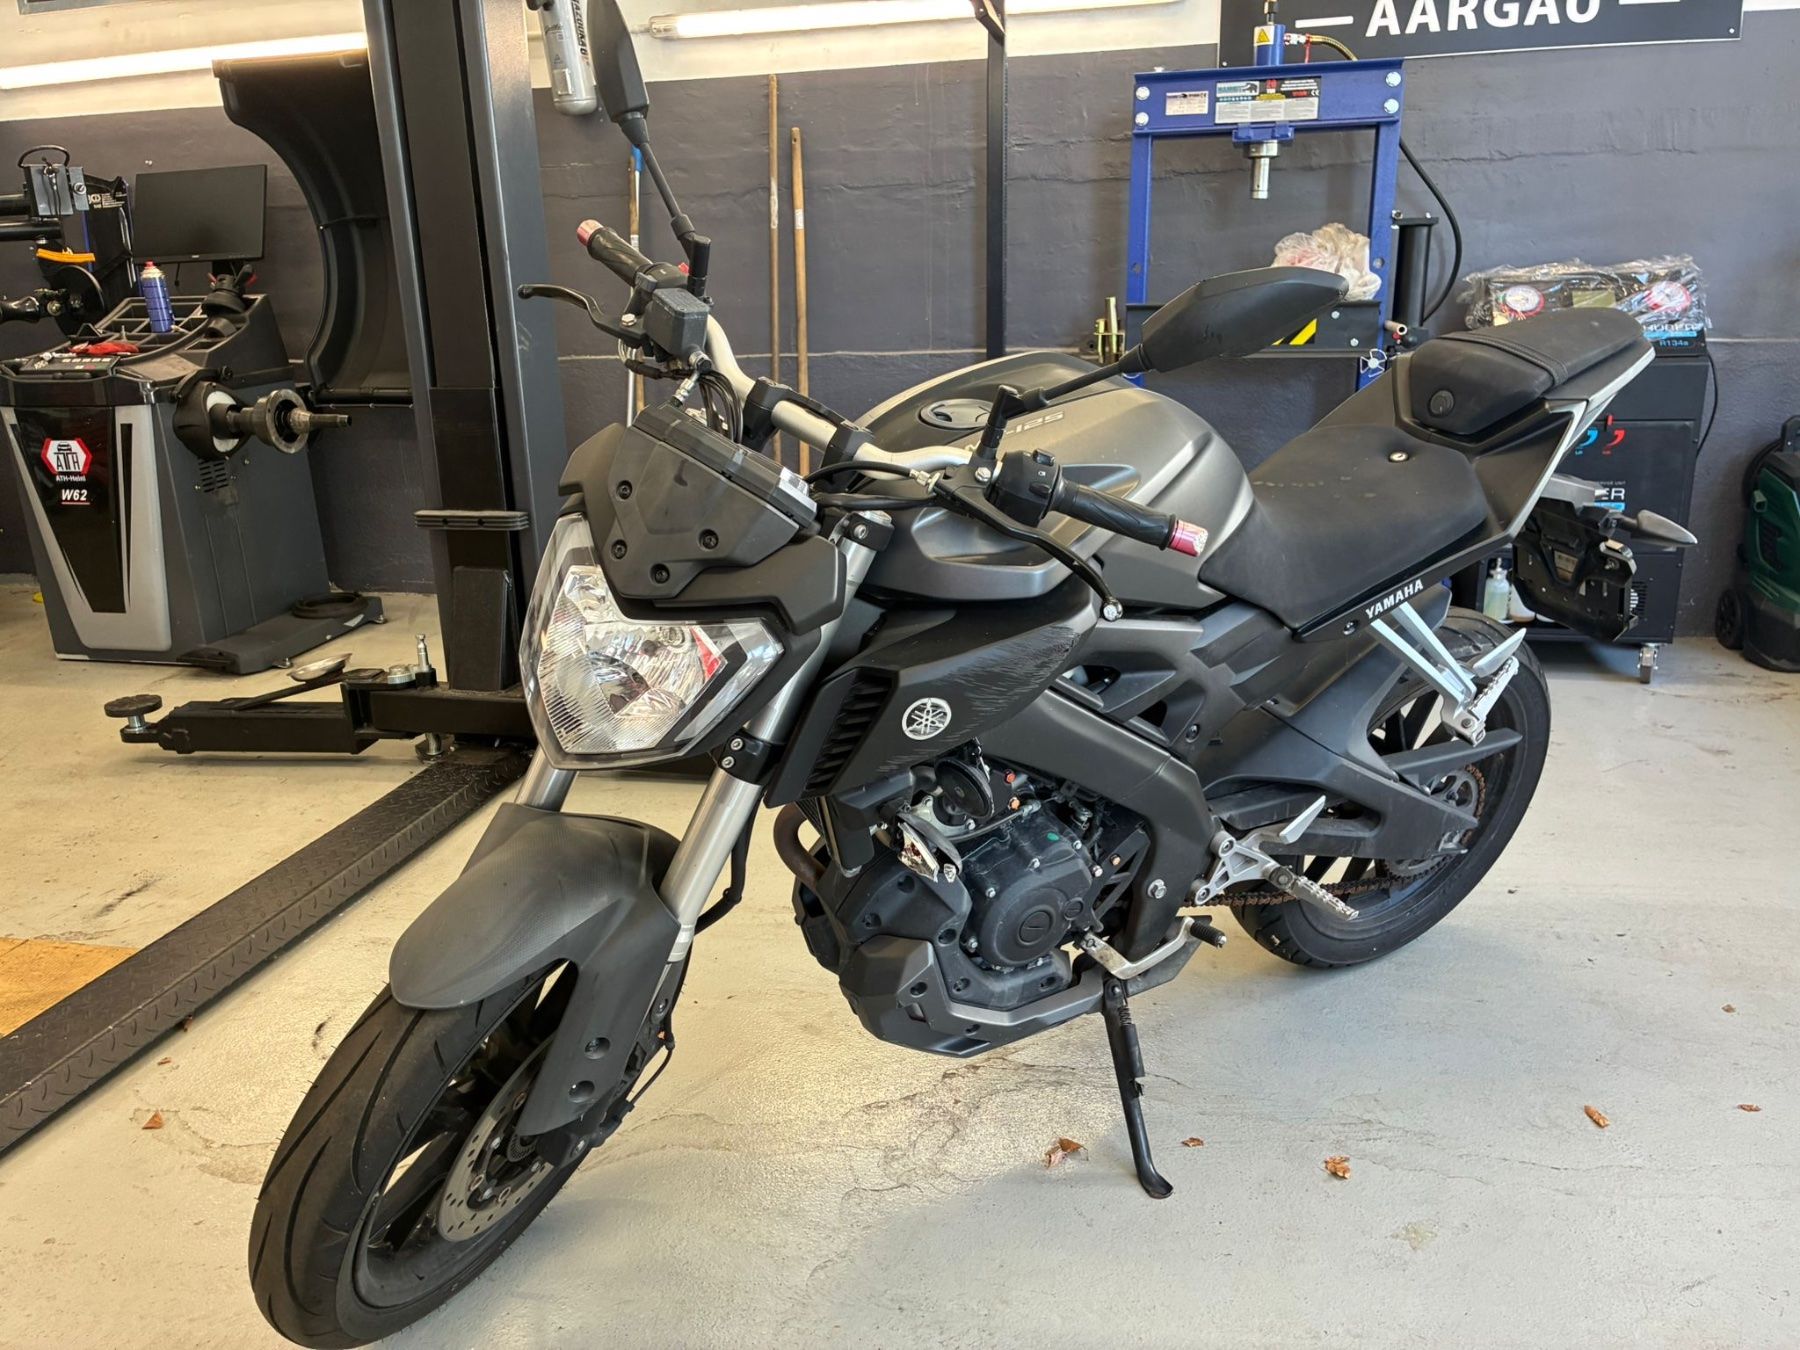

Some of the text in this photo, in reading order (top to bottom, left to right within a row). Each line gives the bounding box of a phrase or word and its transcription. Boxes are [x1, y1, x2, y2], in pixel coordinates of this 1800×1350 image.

[1365, 0, 1600, 37] AARGAU
[61, 488, 88, 501] W62
[1365, 579, 1424, 619] YAMAHA
